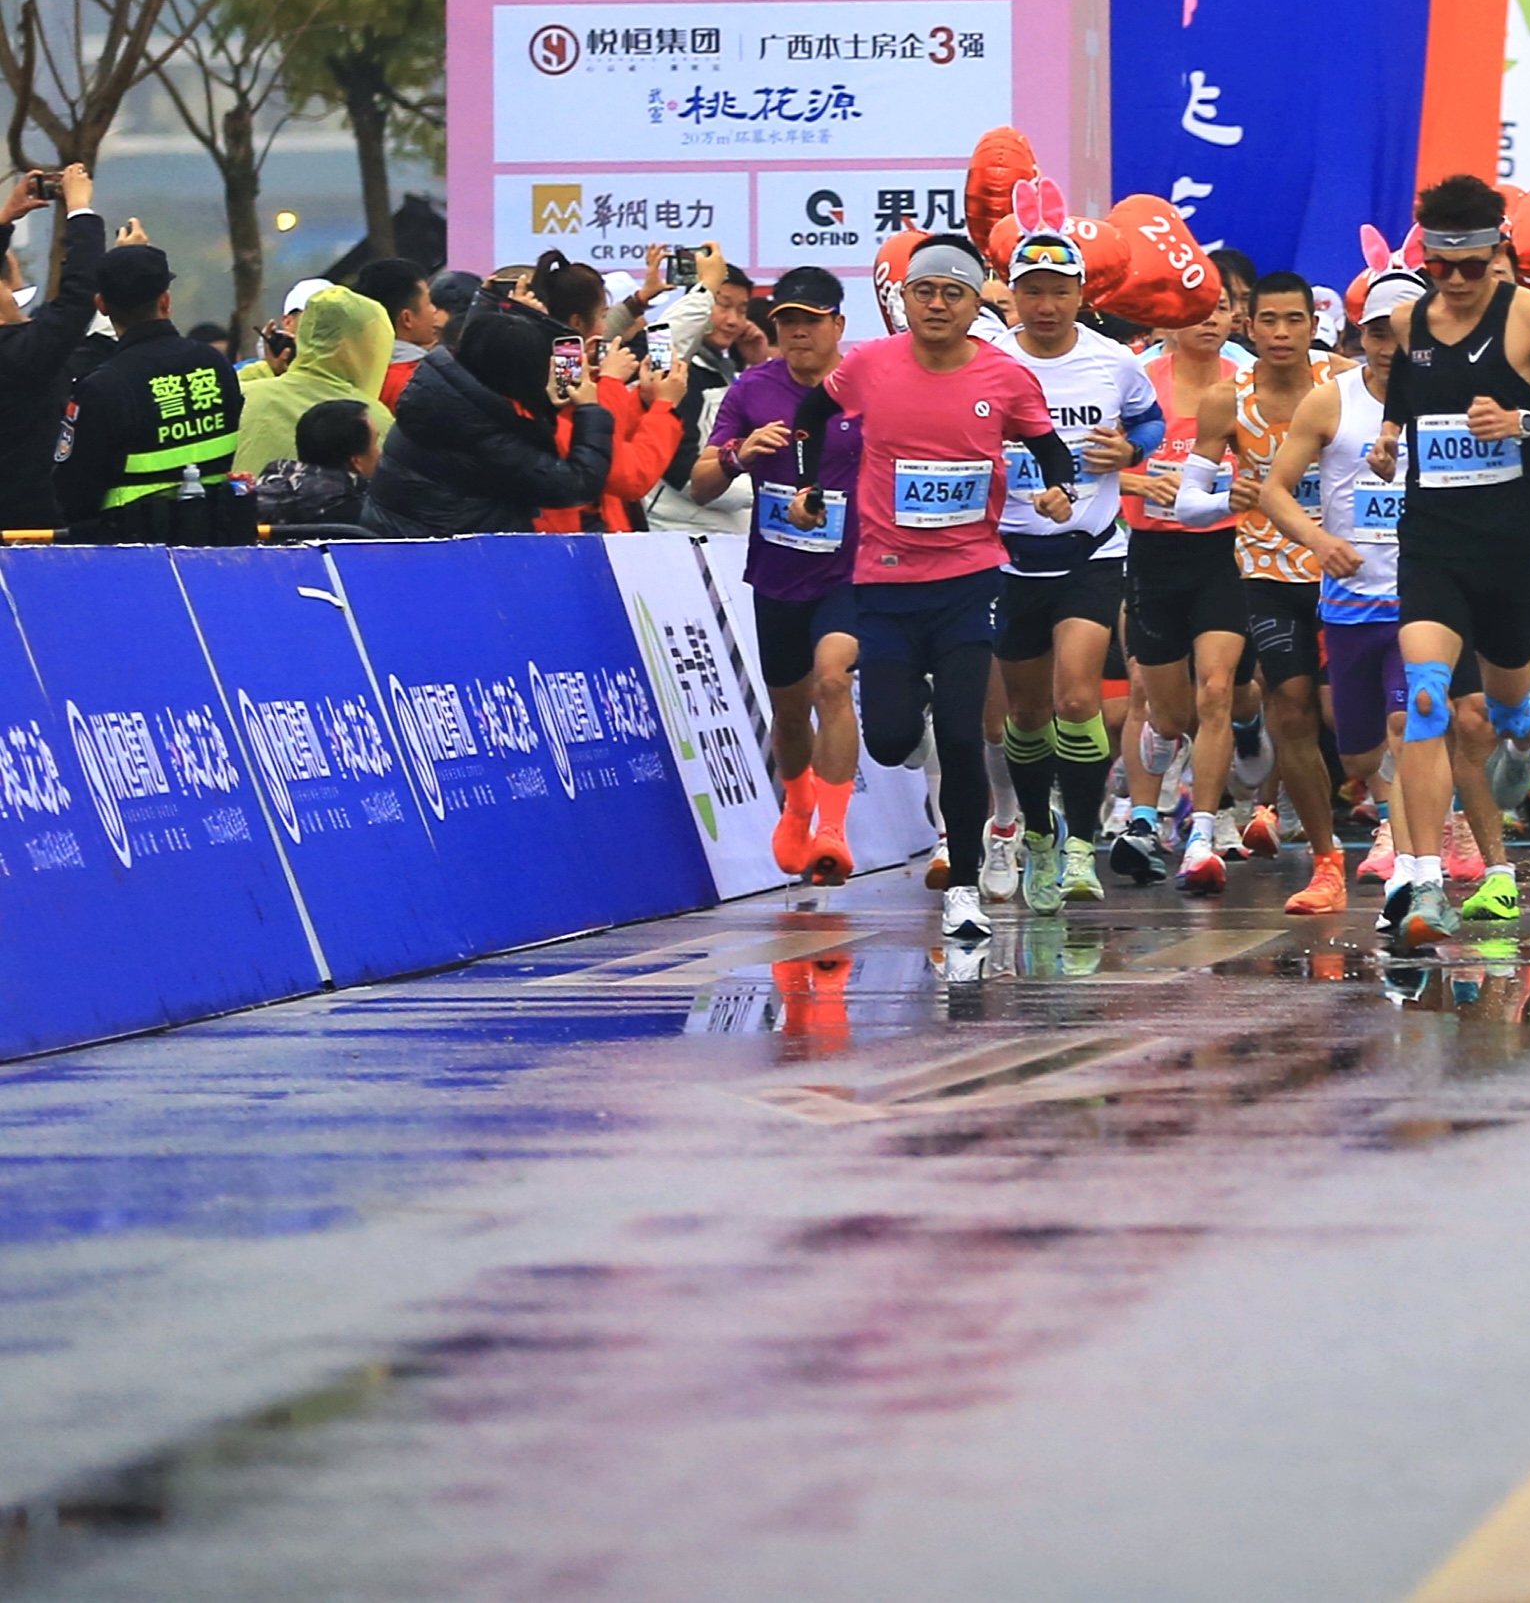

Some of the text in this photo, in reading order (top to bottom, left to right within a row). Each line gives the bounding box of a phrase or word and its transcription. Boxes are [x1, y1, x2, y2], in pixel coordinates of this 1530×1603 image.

[586, 27, 721, 55] 悦恒集团
[759, 26, 986, 66] 广西本土房企3强
[676, 85, 865, 126] 桃花源
[874, 189, 966, 232] 果凡
[591, 245, 616, 261] CR
[1138, 214, 1206, 290] 2:30
[148, 367, 223, 419] 警察
[158, 412, 225, 444] POLICE
[904, 479, 977, 503] A2547
